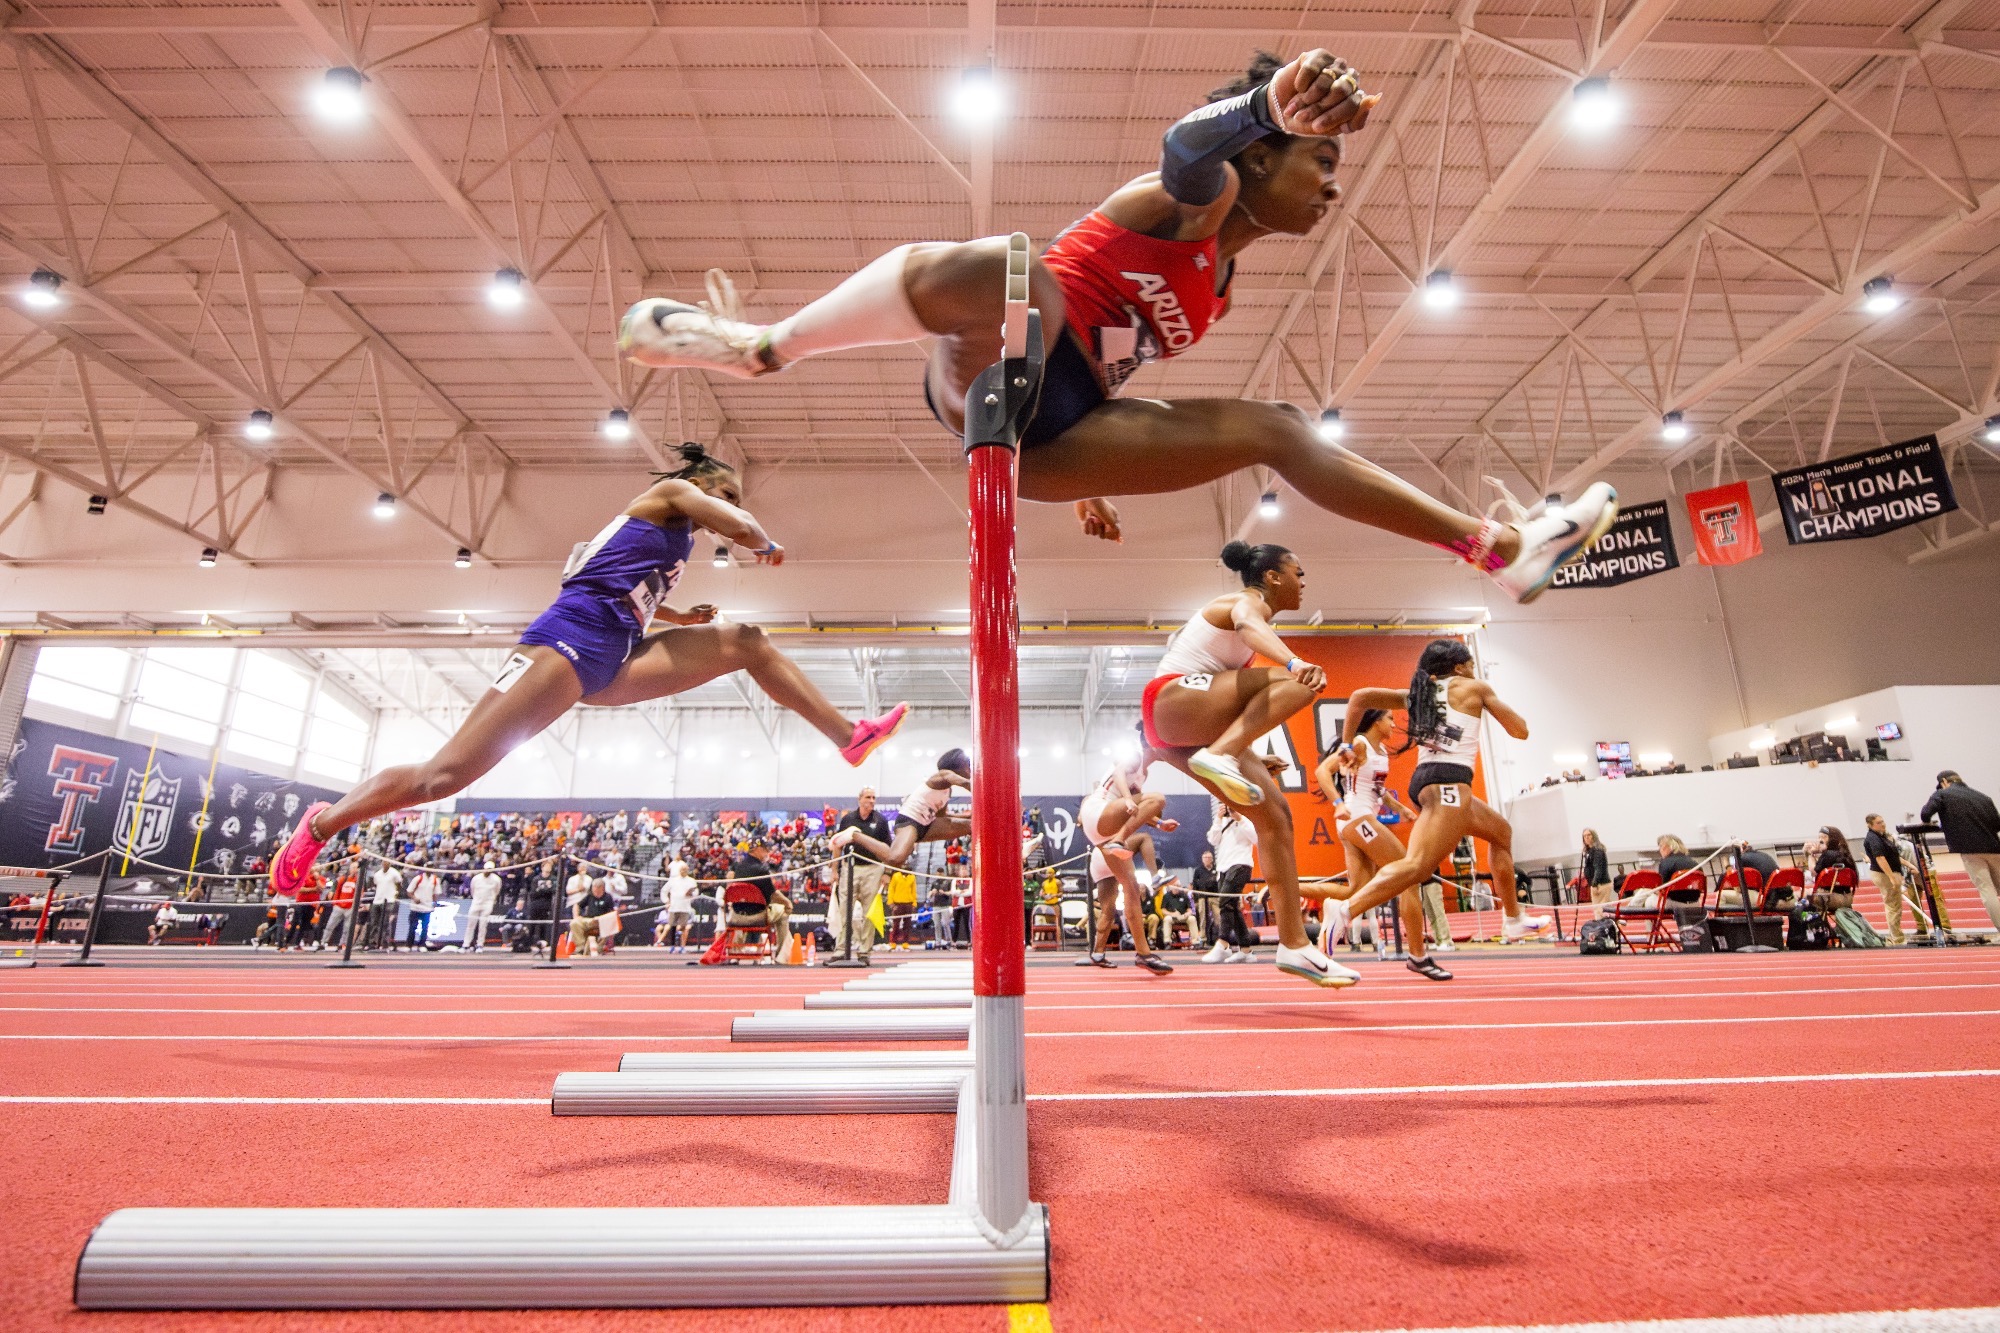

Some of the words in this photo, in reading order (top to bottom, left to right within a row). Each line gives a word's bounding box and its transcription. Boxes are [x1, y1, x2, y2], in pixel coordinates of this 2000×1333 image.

[1120, 271, 1194, 355] ARIZO
[1781, 474, 1804, 487] 2024
[1806, 468, 1831, 480] Men's
[1834, 460, 1864, 474] Indoor
[1865, 451, 1892, 466] Track
[1894, 450, 1903, 459] &
[1905, 442, 1931, 456] Field
[1614, 512, 1633, 523] rack
[1644, 506, 1664, 516] Field
[1799, 492, 1941, 540] CHAMPIONS
[1553, 551, 1666, 586] CHAMPIONS
[495, 657, 525, 684] 7
[1443, 787, 1456, 804] 5
[117, 803, 164, 848] NFL
[1361, 824, 1374, 838] 4
